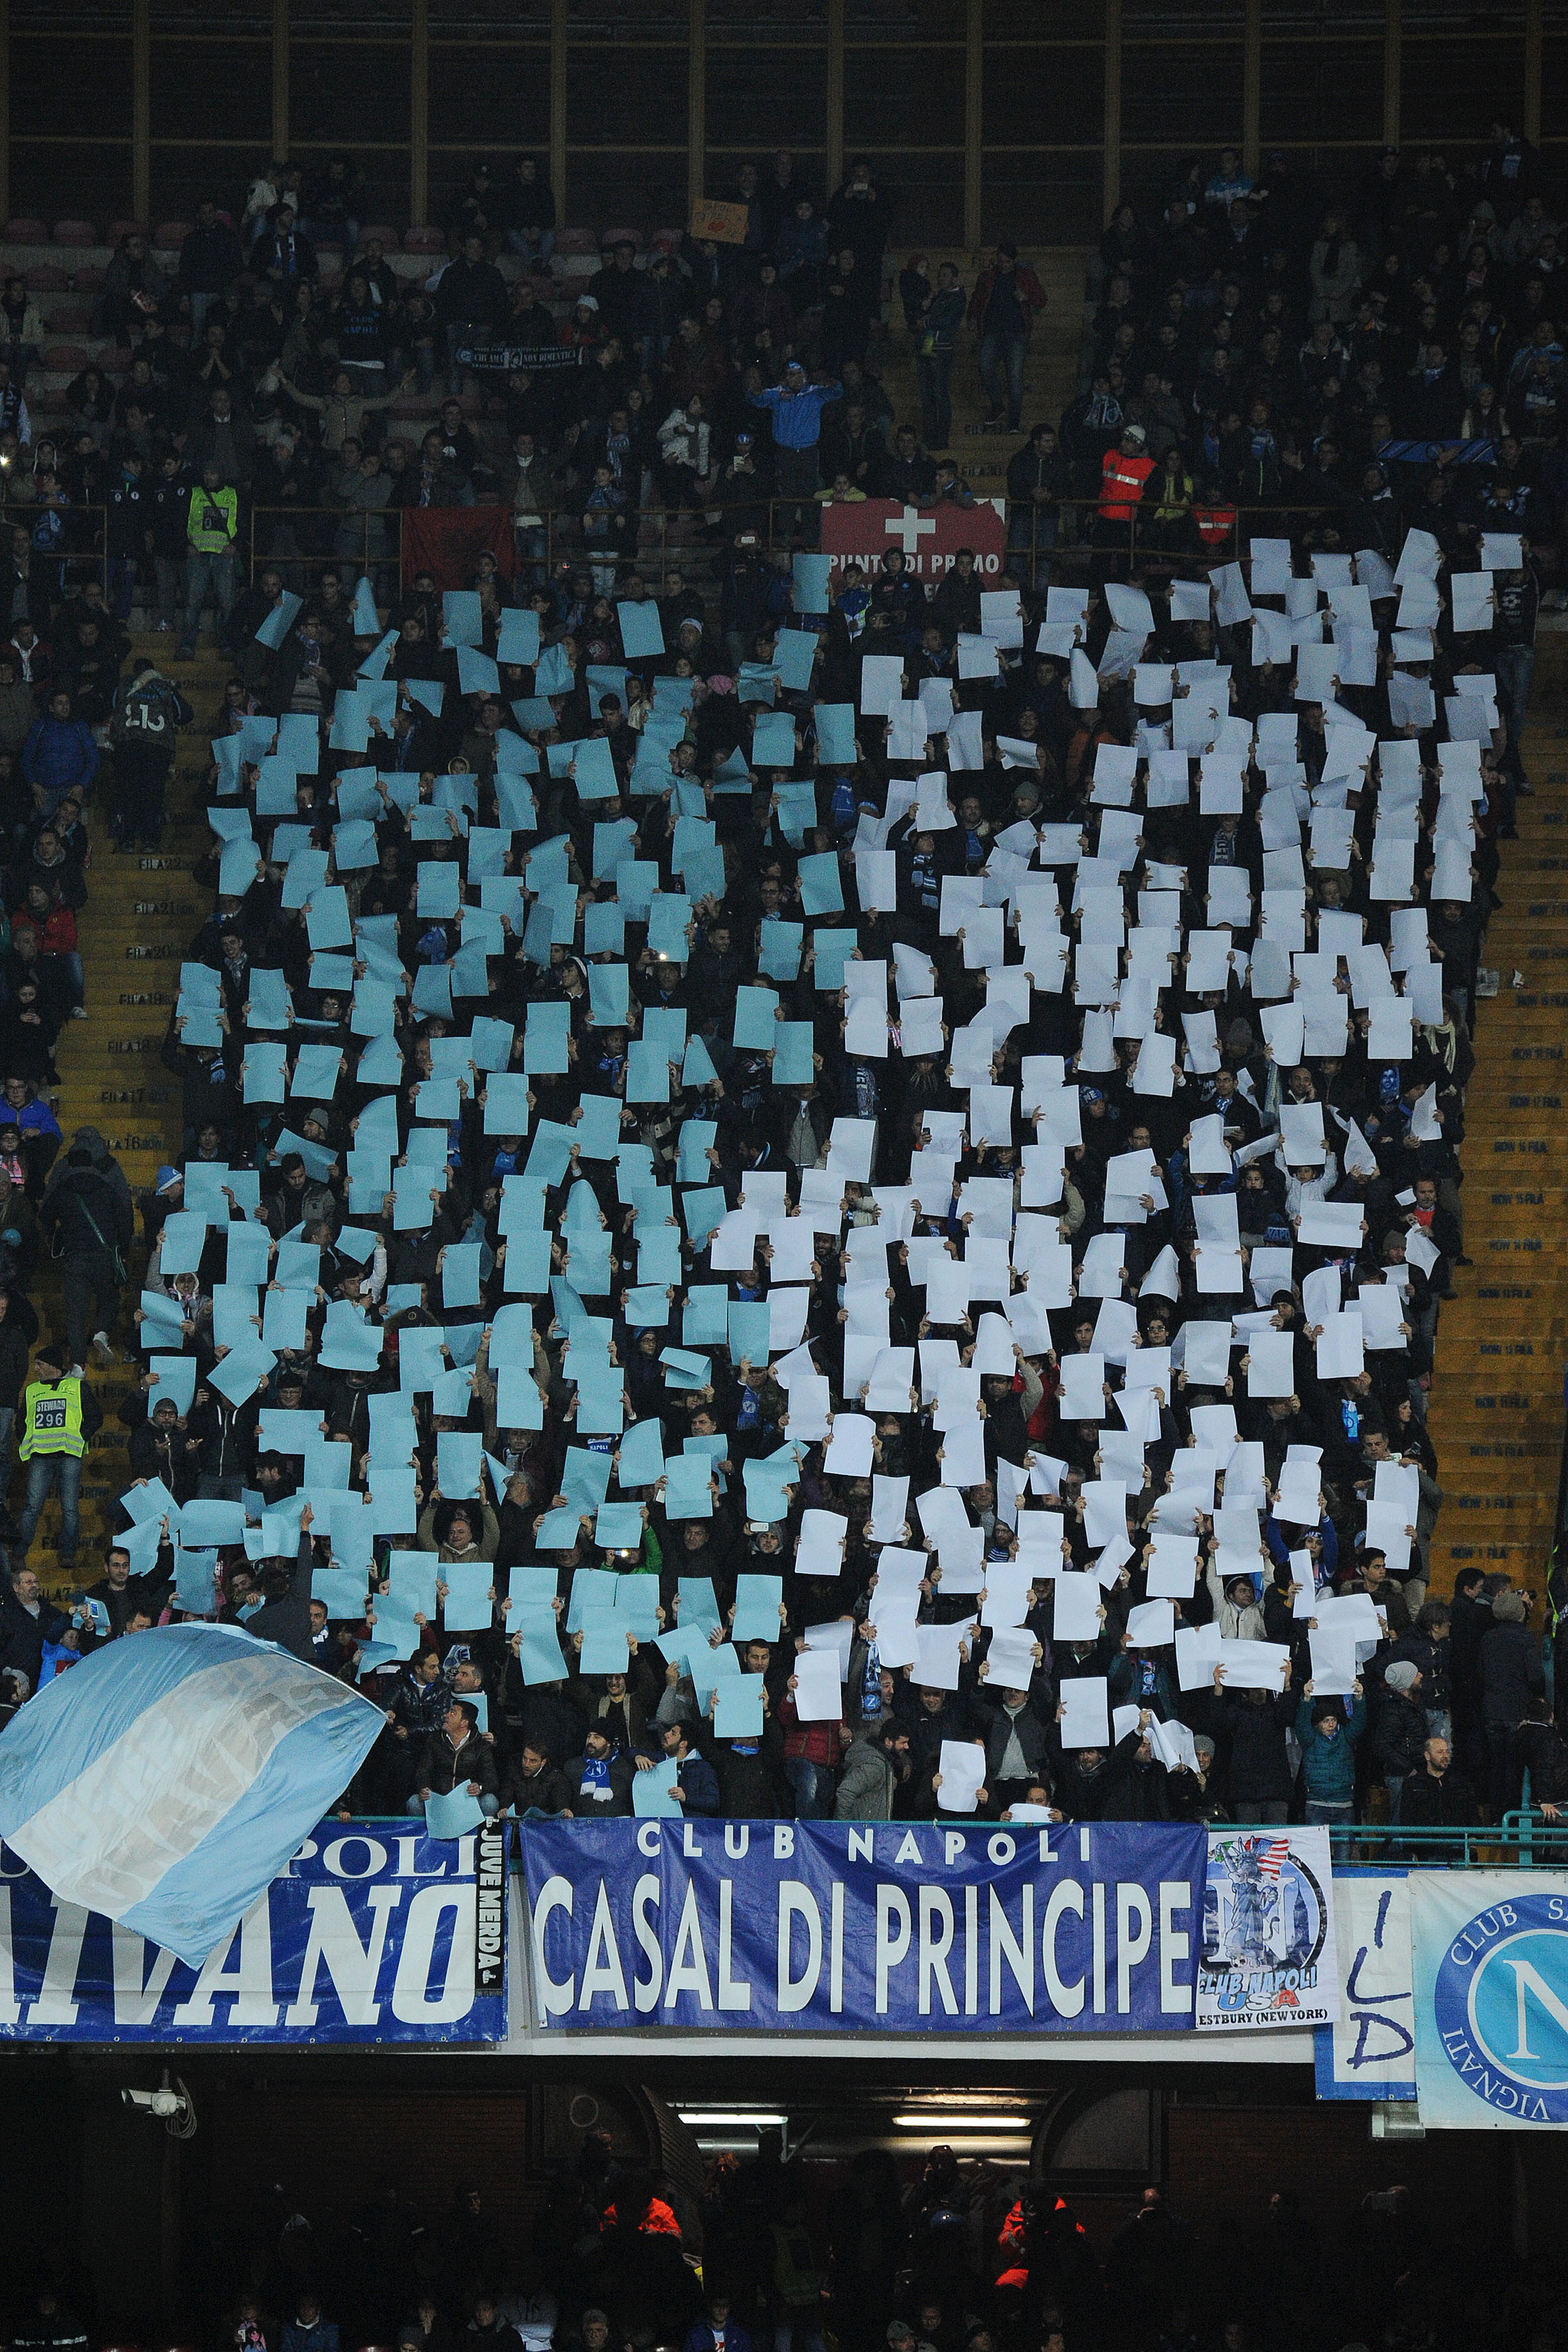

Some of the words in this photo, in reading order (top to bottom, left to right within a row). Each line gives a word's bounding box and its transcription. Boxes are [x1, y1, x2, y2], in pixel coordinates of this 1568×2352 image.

[830, 554, 888, 574] PUNT
[931, 554, 1000, 574] PRMO
[35, 1413, 64, 1427] 296
[36, 1399, 66, 1413] STEWARD
[275, 1835, 476, 1879] POLI
[480, 1829, 503, 1887] JUVE
[637, 1822, 795, 1860] CLUB
[848, 1826, 1090, 1867] NAPOLI
[478, 1889, 501, 1970] MERDA
[533, 1873, 751, 2017] CASAL
[777, 1879, 844, 2015] DI
[875, 1878, 1192, 2019] PRINCIPE
[1450, 1904, 1518, 1966] CLUB
[1547, 1898, 1568, 1921] S
[0, 1884, 476, 2025] IVANO
[1199, 1972, 1243, 1996] CLUB
[1249, 1964, 1317, 1994] NAPOLI
[1217, 1989, 1300, 2011] USA
[1199, 2013, 1253, 2025] ESTBURY
[1346, 2011, 1415, 2070] D
[1442, 2027, 1551, 2121] VIGNATI
